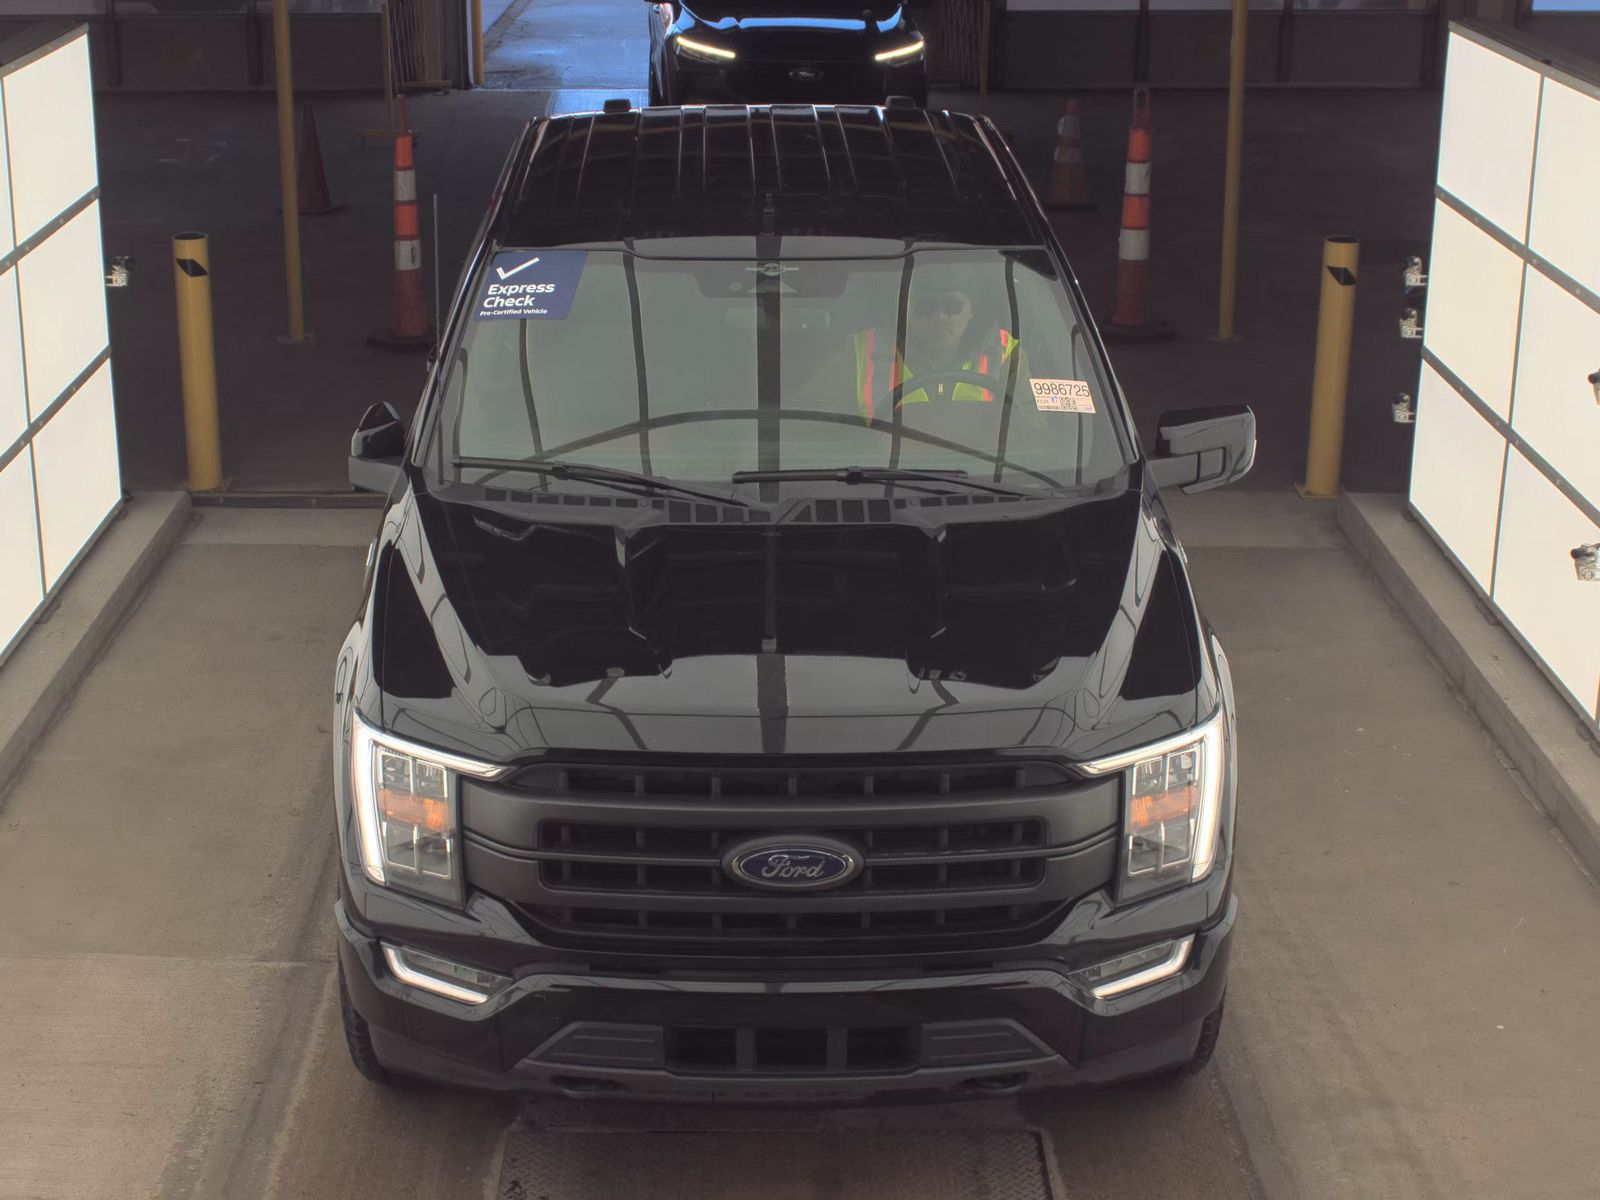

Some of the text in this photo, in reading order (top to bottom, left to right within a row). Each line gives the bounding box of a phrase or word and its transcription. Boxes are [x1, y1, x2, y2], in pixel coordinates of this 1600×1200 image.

[487, 283, 555, 296] Express
[483, 295, 536, 308] Check
[1033, 382, 1090, 397] 9986725
[761, 854, 826, 878] Ford
